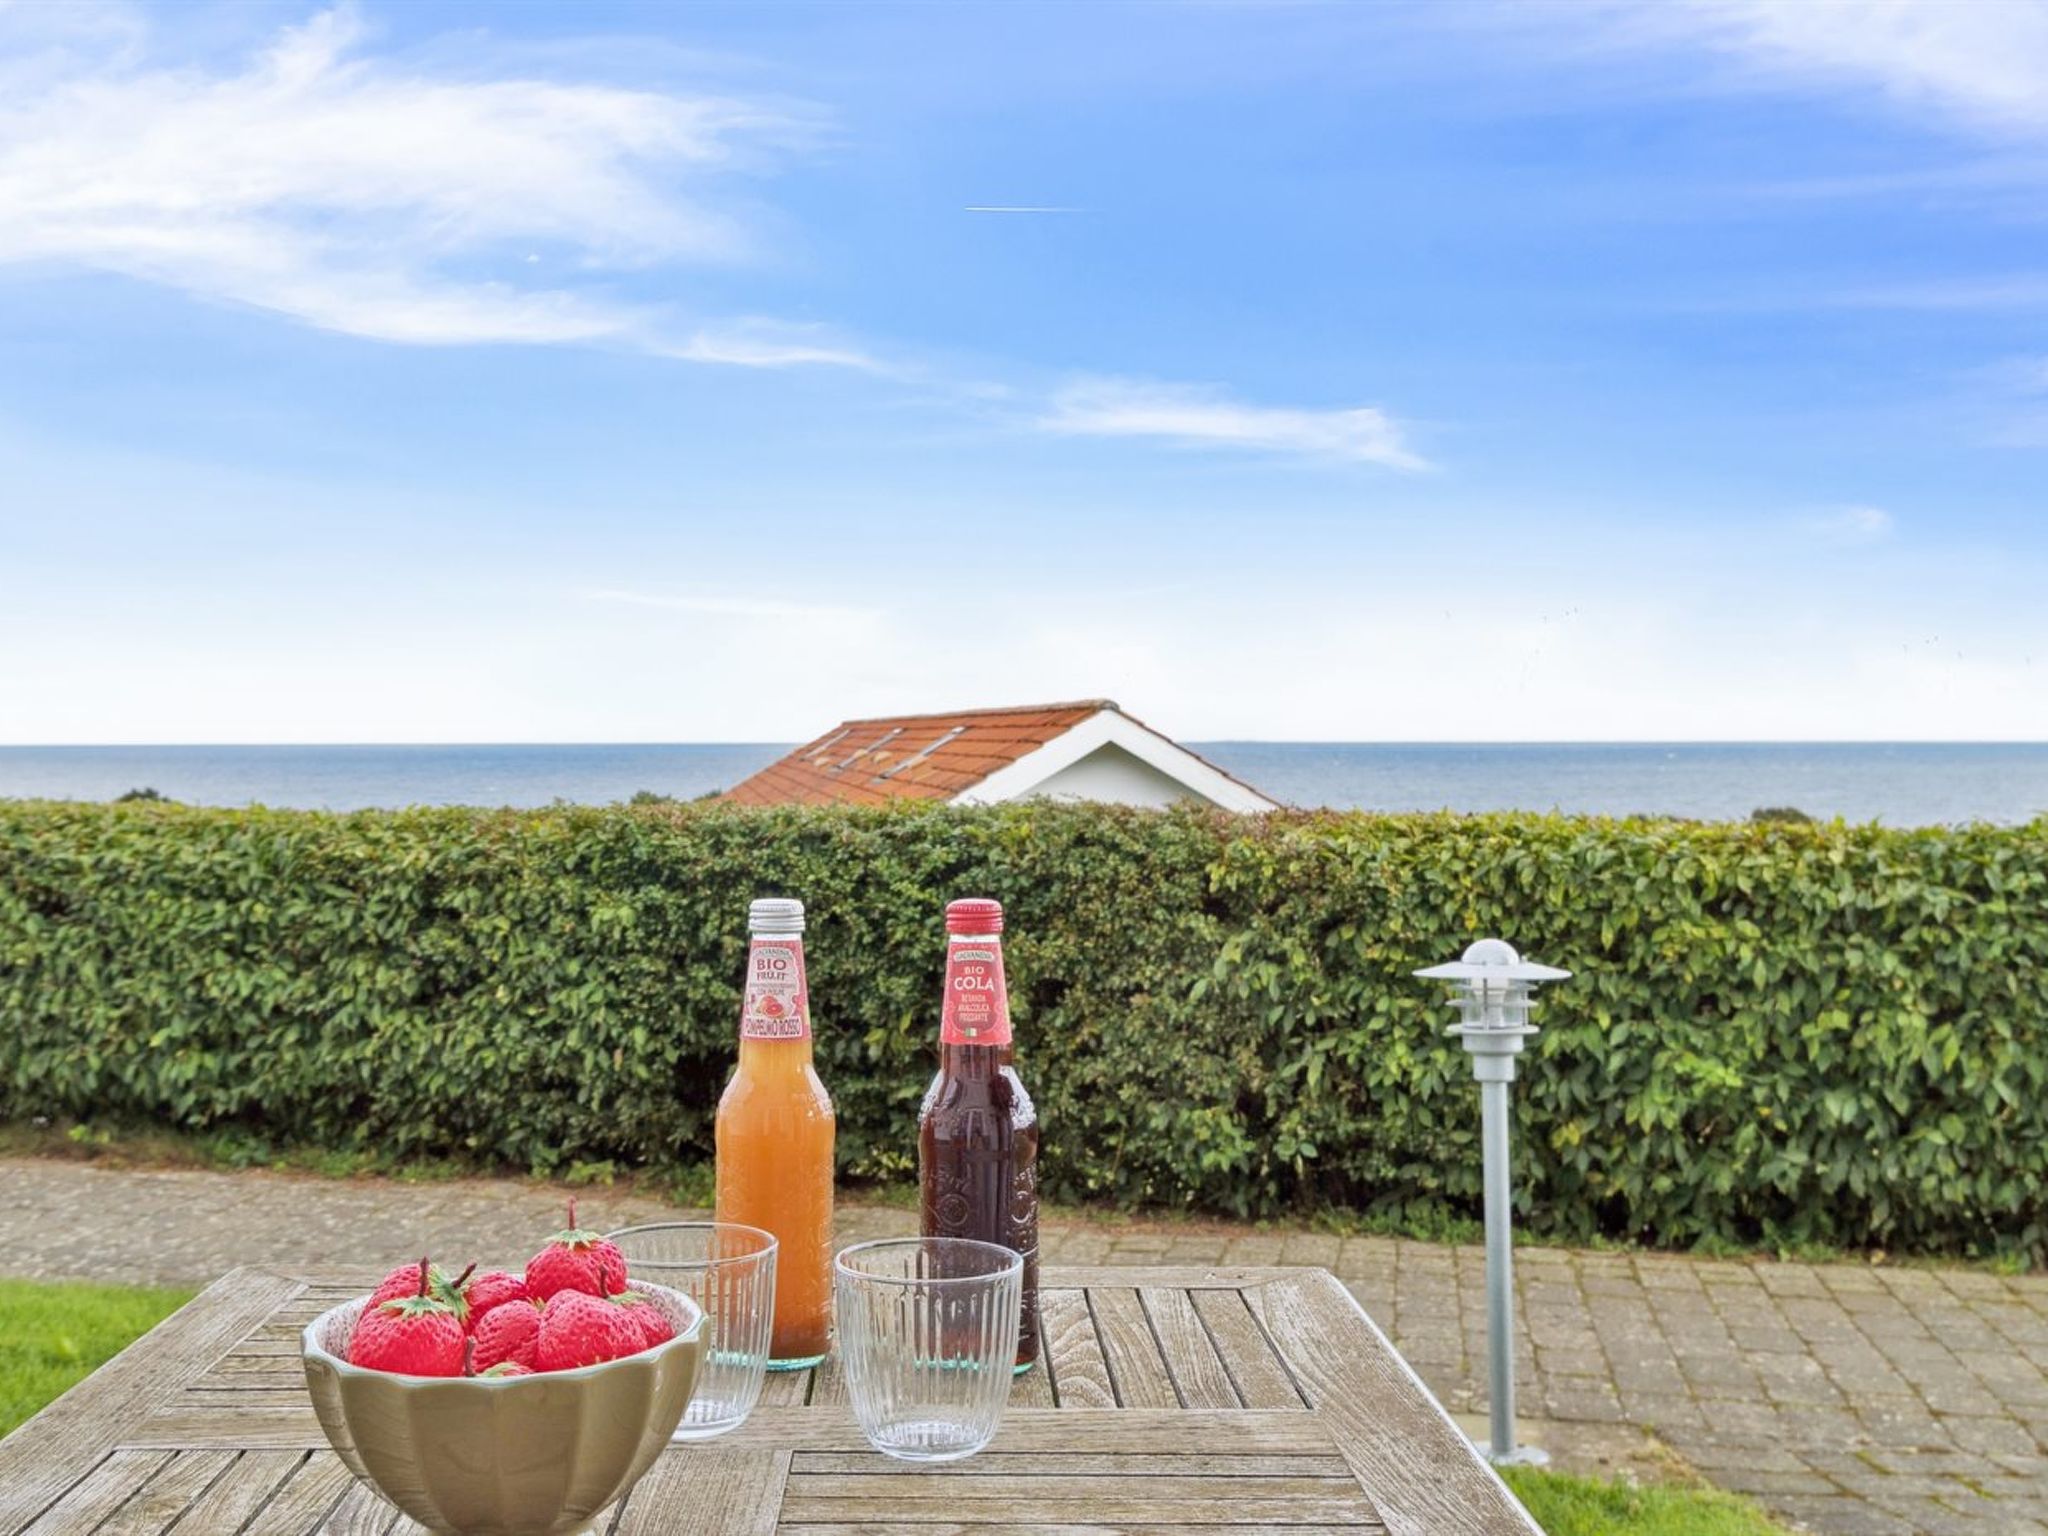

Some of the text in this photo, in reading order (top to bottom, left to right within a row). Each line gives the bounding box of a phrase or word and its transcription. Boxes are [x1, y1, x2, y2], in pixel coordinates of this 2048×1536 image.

[757, 958, 787, 970] BIO
[964, 966, 985, 975] BIO
[757, 972, 788, 981] FRUIT
[954, 976, 995, 991] COLA
